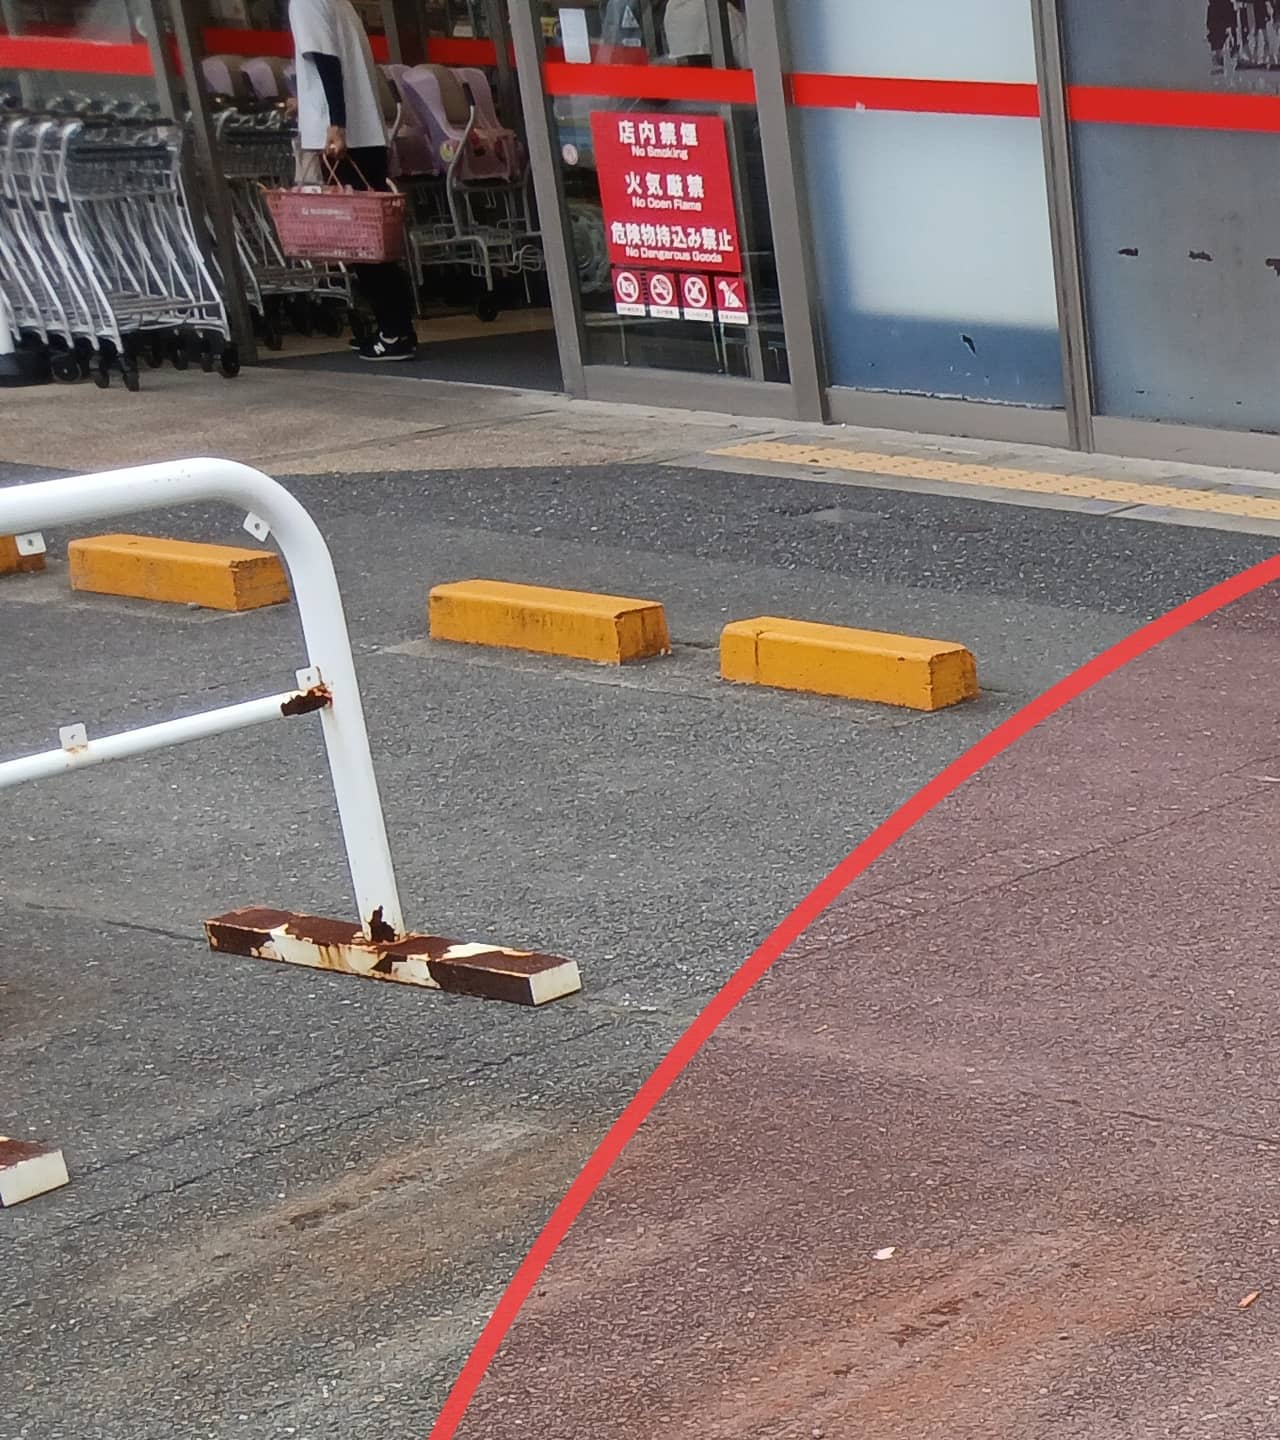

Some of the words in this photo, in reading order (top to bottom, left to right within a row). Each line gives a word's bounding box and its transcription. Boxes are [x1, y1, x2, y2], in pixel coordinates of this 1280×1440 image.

[618, 120, 698, 146] 店内禁煙
[631, 146, 646, 157] No
[647, 146, 688, 160] Smoking
[624, 171, 704, 198] 火気厳禁
[632, 196, 646, 208] No
[647, 198, 672, 210] Open
[674, 199, 702, 211] Flame
[611, 221, 733, 251] 危険物持込み禁止
[625, 246, 639, 257] No
[641, 248, 691, 261] Dangerous
[693, 251, 722, 263] Goods
